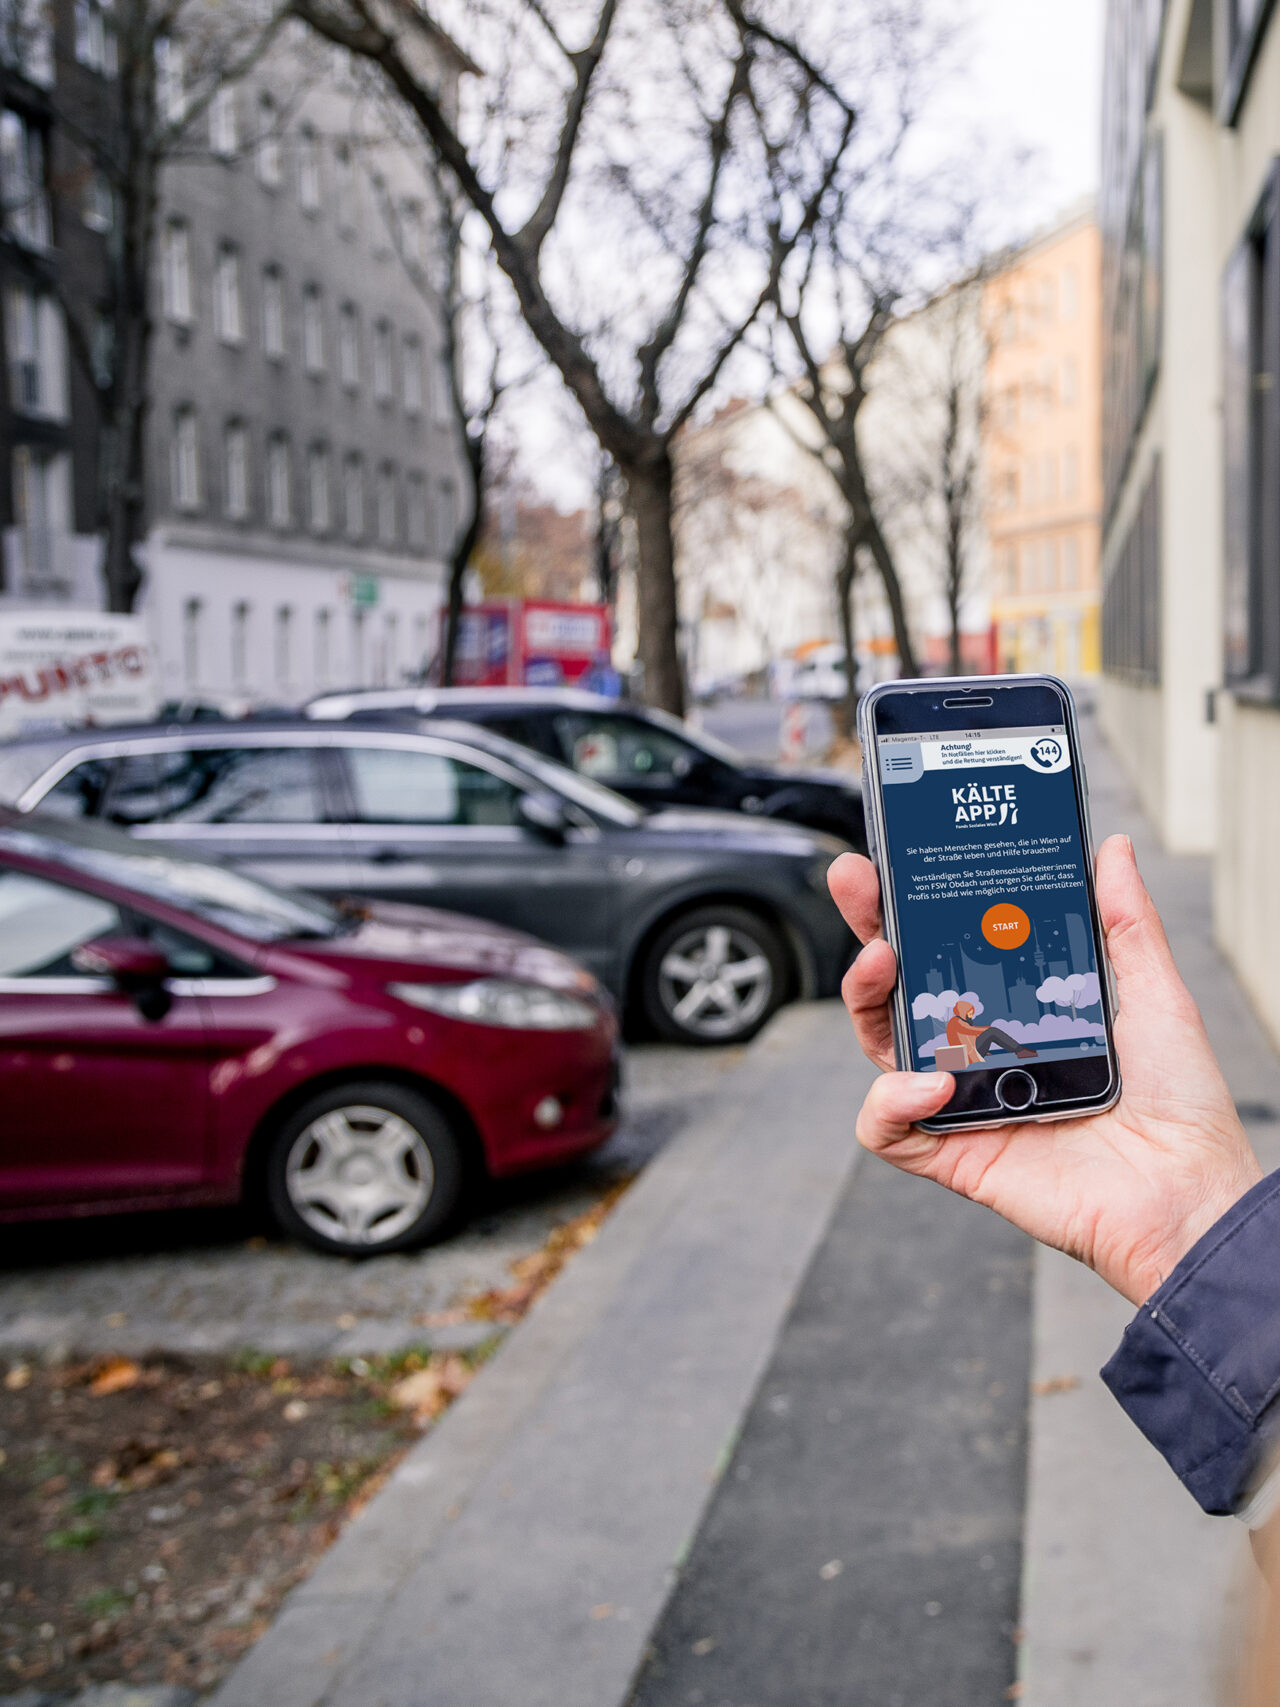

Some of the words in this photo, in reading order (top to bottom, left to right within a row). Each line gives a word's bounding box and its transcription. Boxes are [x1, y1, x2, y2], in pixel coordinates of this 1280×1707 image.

[941, 743, 972, 751] Achtung!
[1040, 746, 1058, 756] 144
[952, 782, 1017, 804] KÄLTE
[955, 804, 997, 822] APP
[919, 846, 943, 854] haben
[944, 843, 982, 852] Menschen
[984, 841, 1016, 850] gesehen,
[1060, 835, 1072, 843] auf
[938, 854, 962, 862] Straße
[987, 850, 1001, 858] und
[1022, 846, 1060, 855] brauchen?
[912, 872, 961, 882] Verständigen
[963, 870, 974, 878] Sie
[976, 863, 1076, 877] Straßensozialarbeiter:innen
[908, 892, 929, 900] Profis
[941, 890, 958, 898] bald
[975, 886, 1005, 896] möglich
[1020, 884, 1033, 892] Ort
[1035, 880, 1084, 890] unterstützen!
[931, 882, 947, 890] FSW
[949, 880, 977, 888] Obdach
[980, 878, 994, 886] und
[1034, 873, 1056, 881] dafür,
[992, 922, 1019, 932] START
